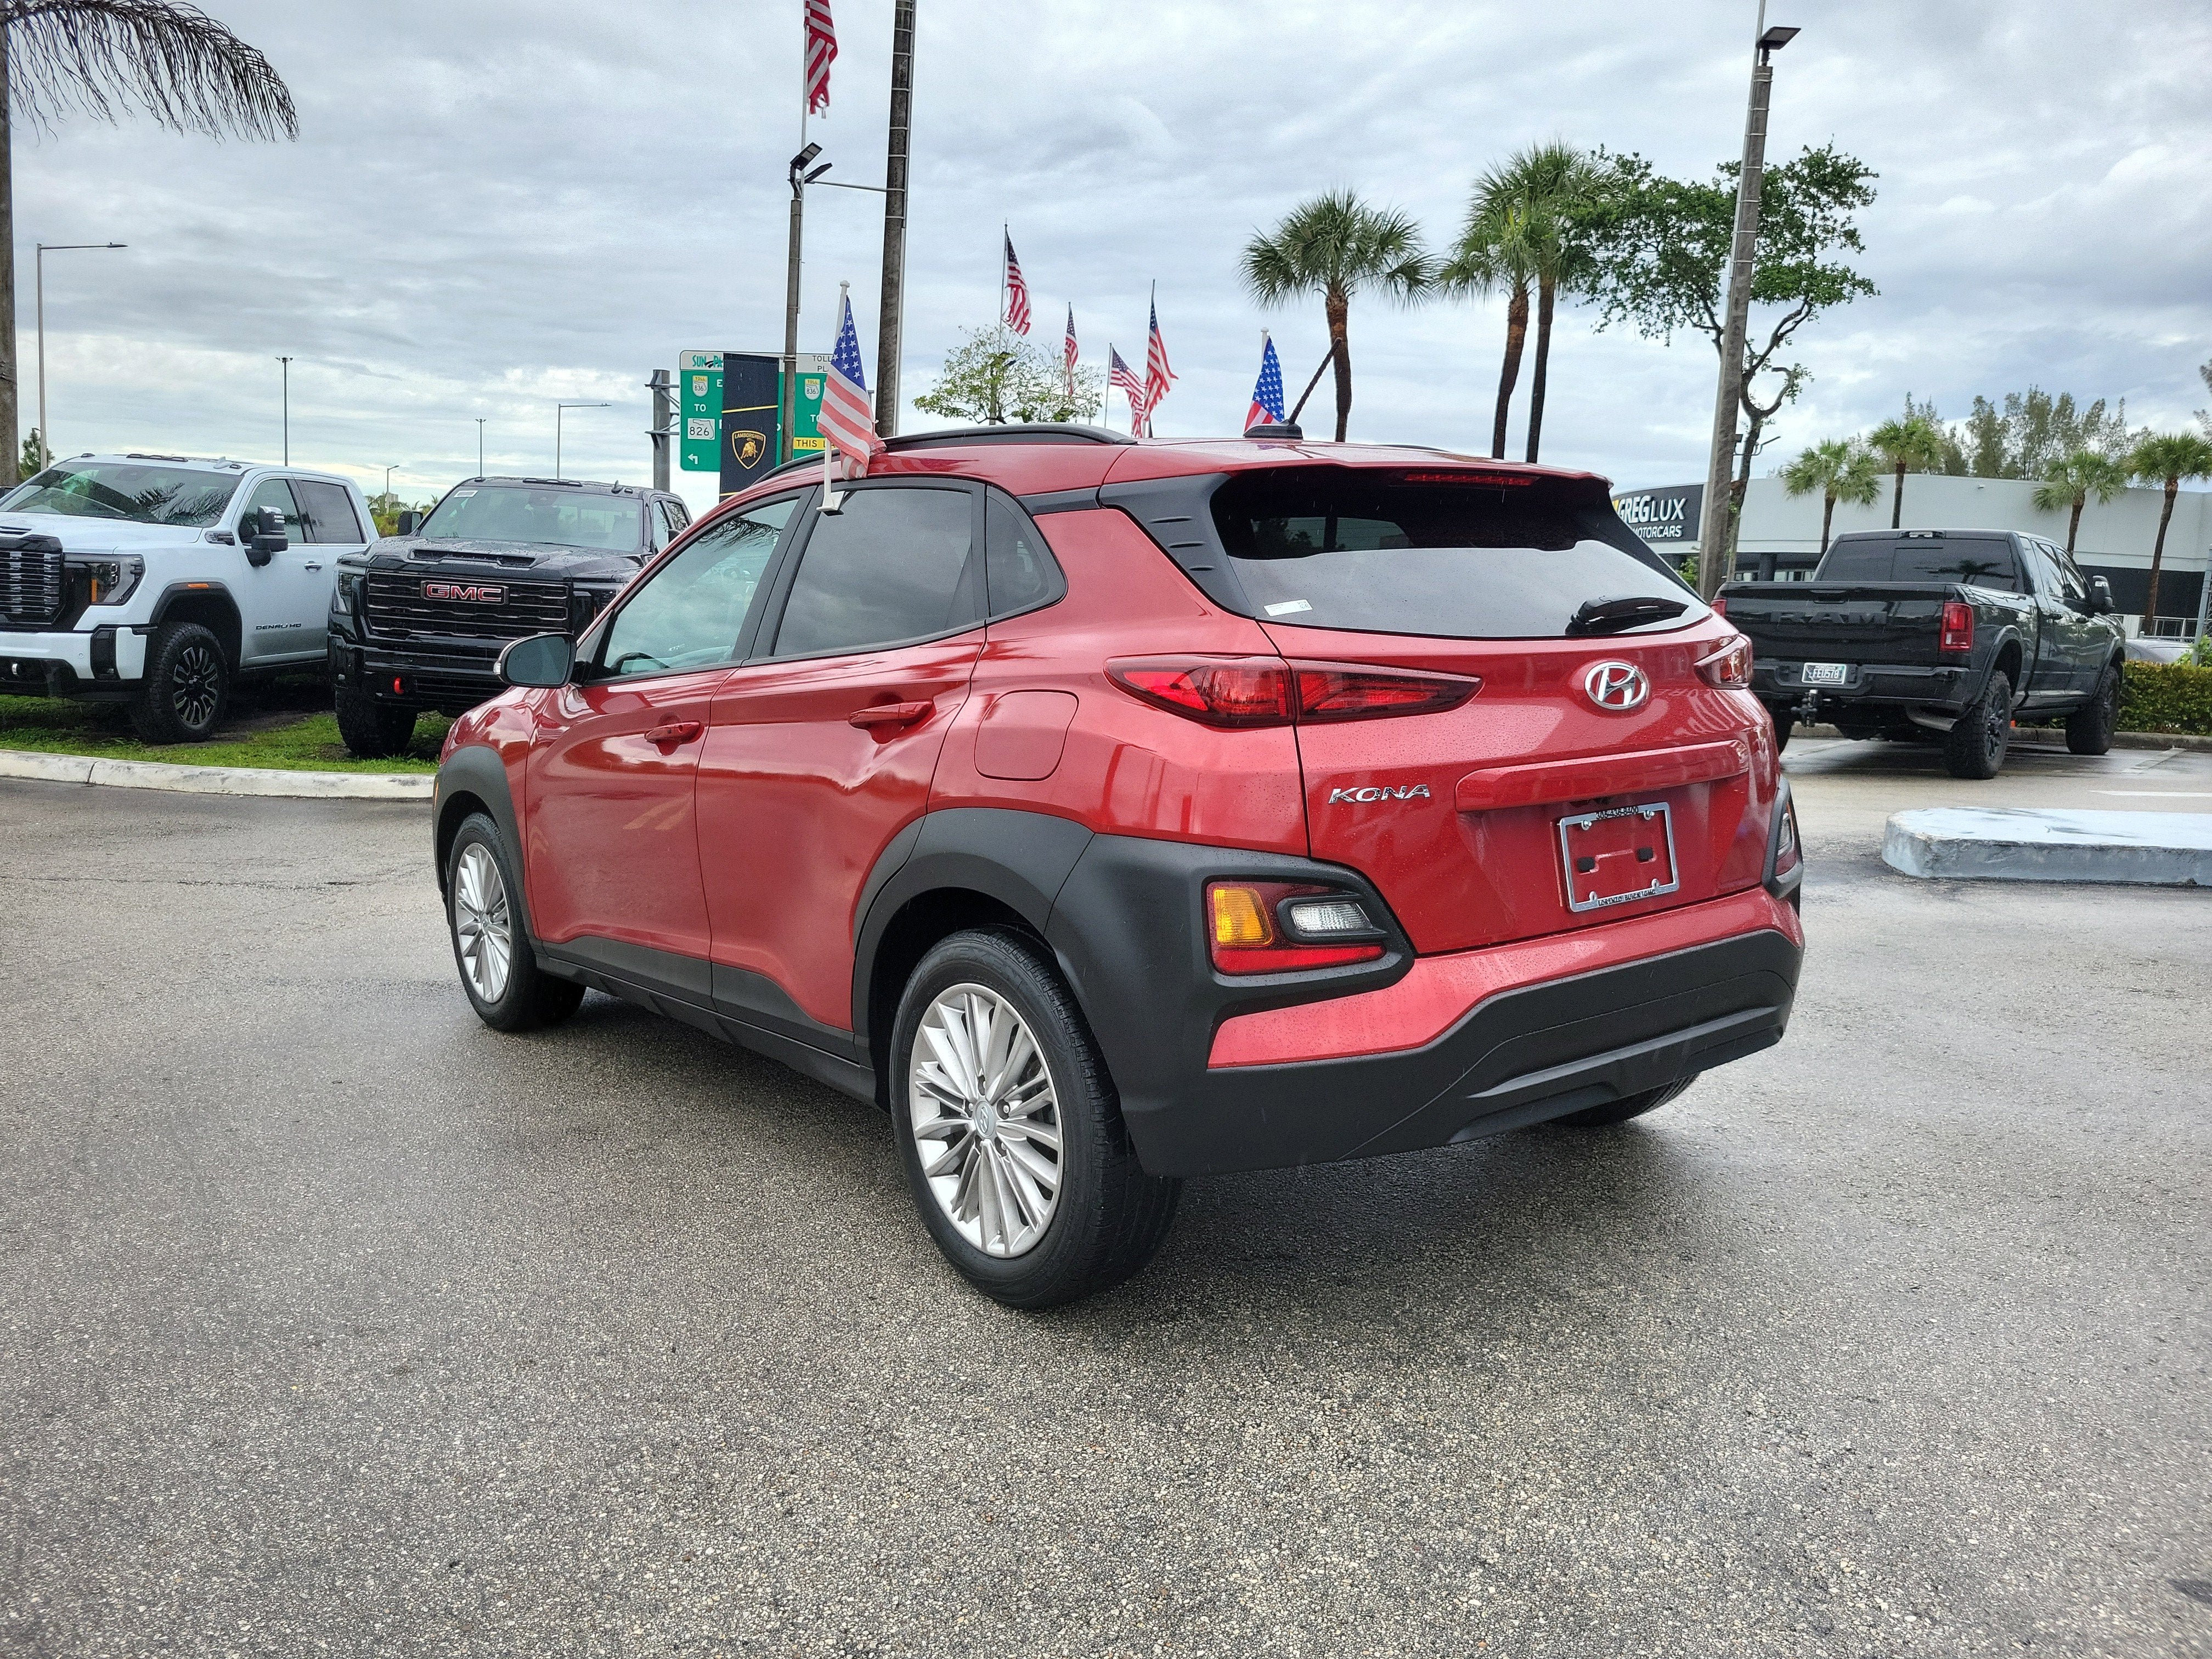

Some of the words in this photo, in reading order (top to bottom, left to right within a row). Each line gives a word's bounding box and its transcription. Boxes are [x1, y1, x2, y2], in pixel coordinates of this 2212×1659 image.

[693, 404, 707, 412] TO
[689, 426, 709, 436] 826
[796, 439, 817, 448] THIS
[426, 584, 502, 602] GMC
[1770, 611, 1888, 624] RAM
[1328, 784, 1431, 804] KONA
[1598, 896, 1622, 906] LORENZO
